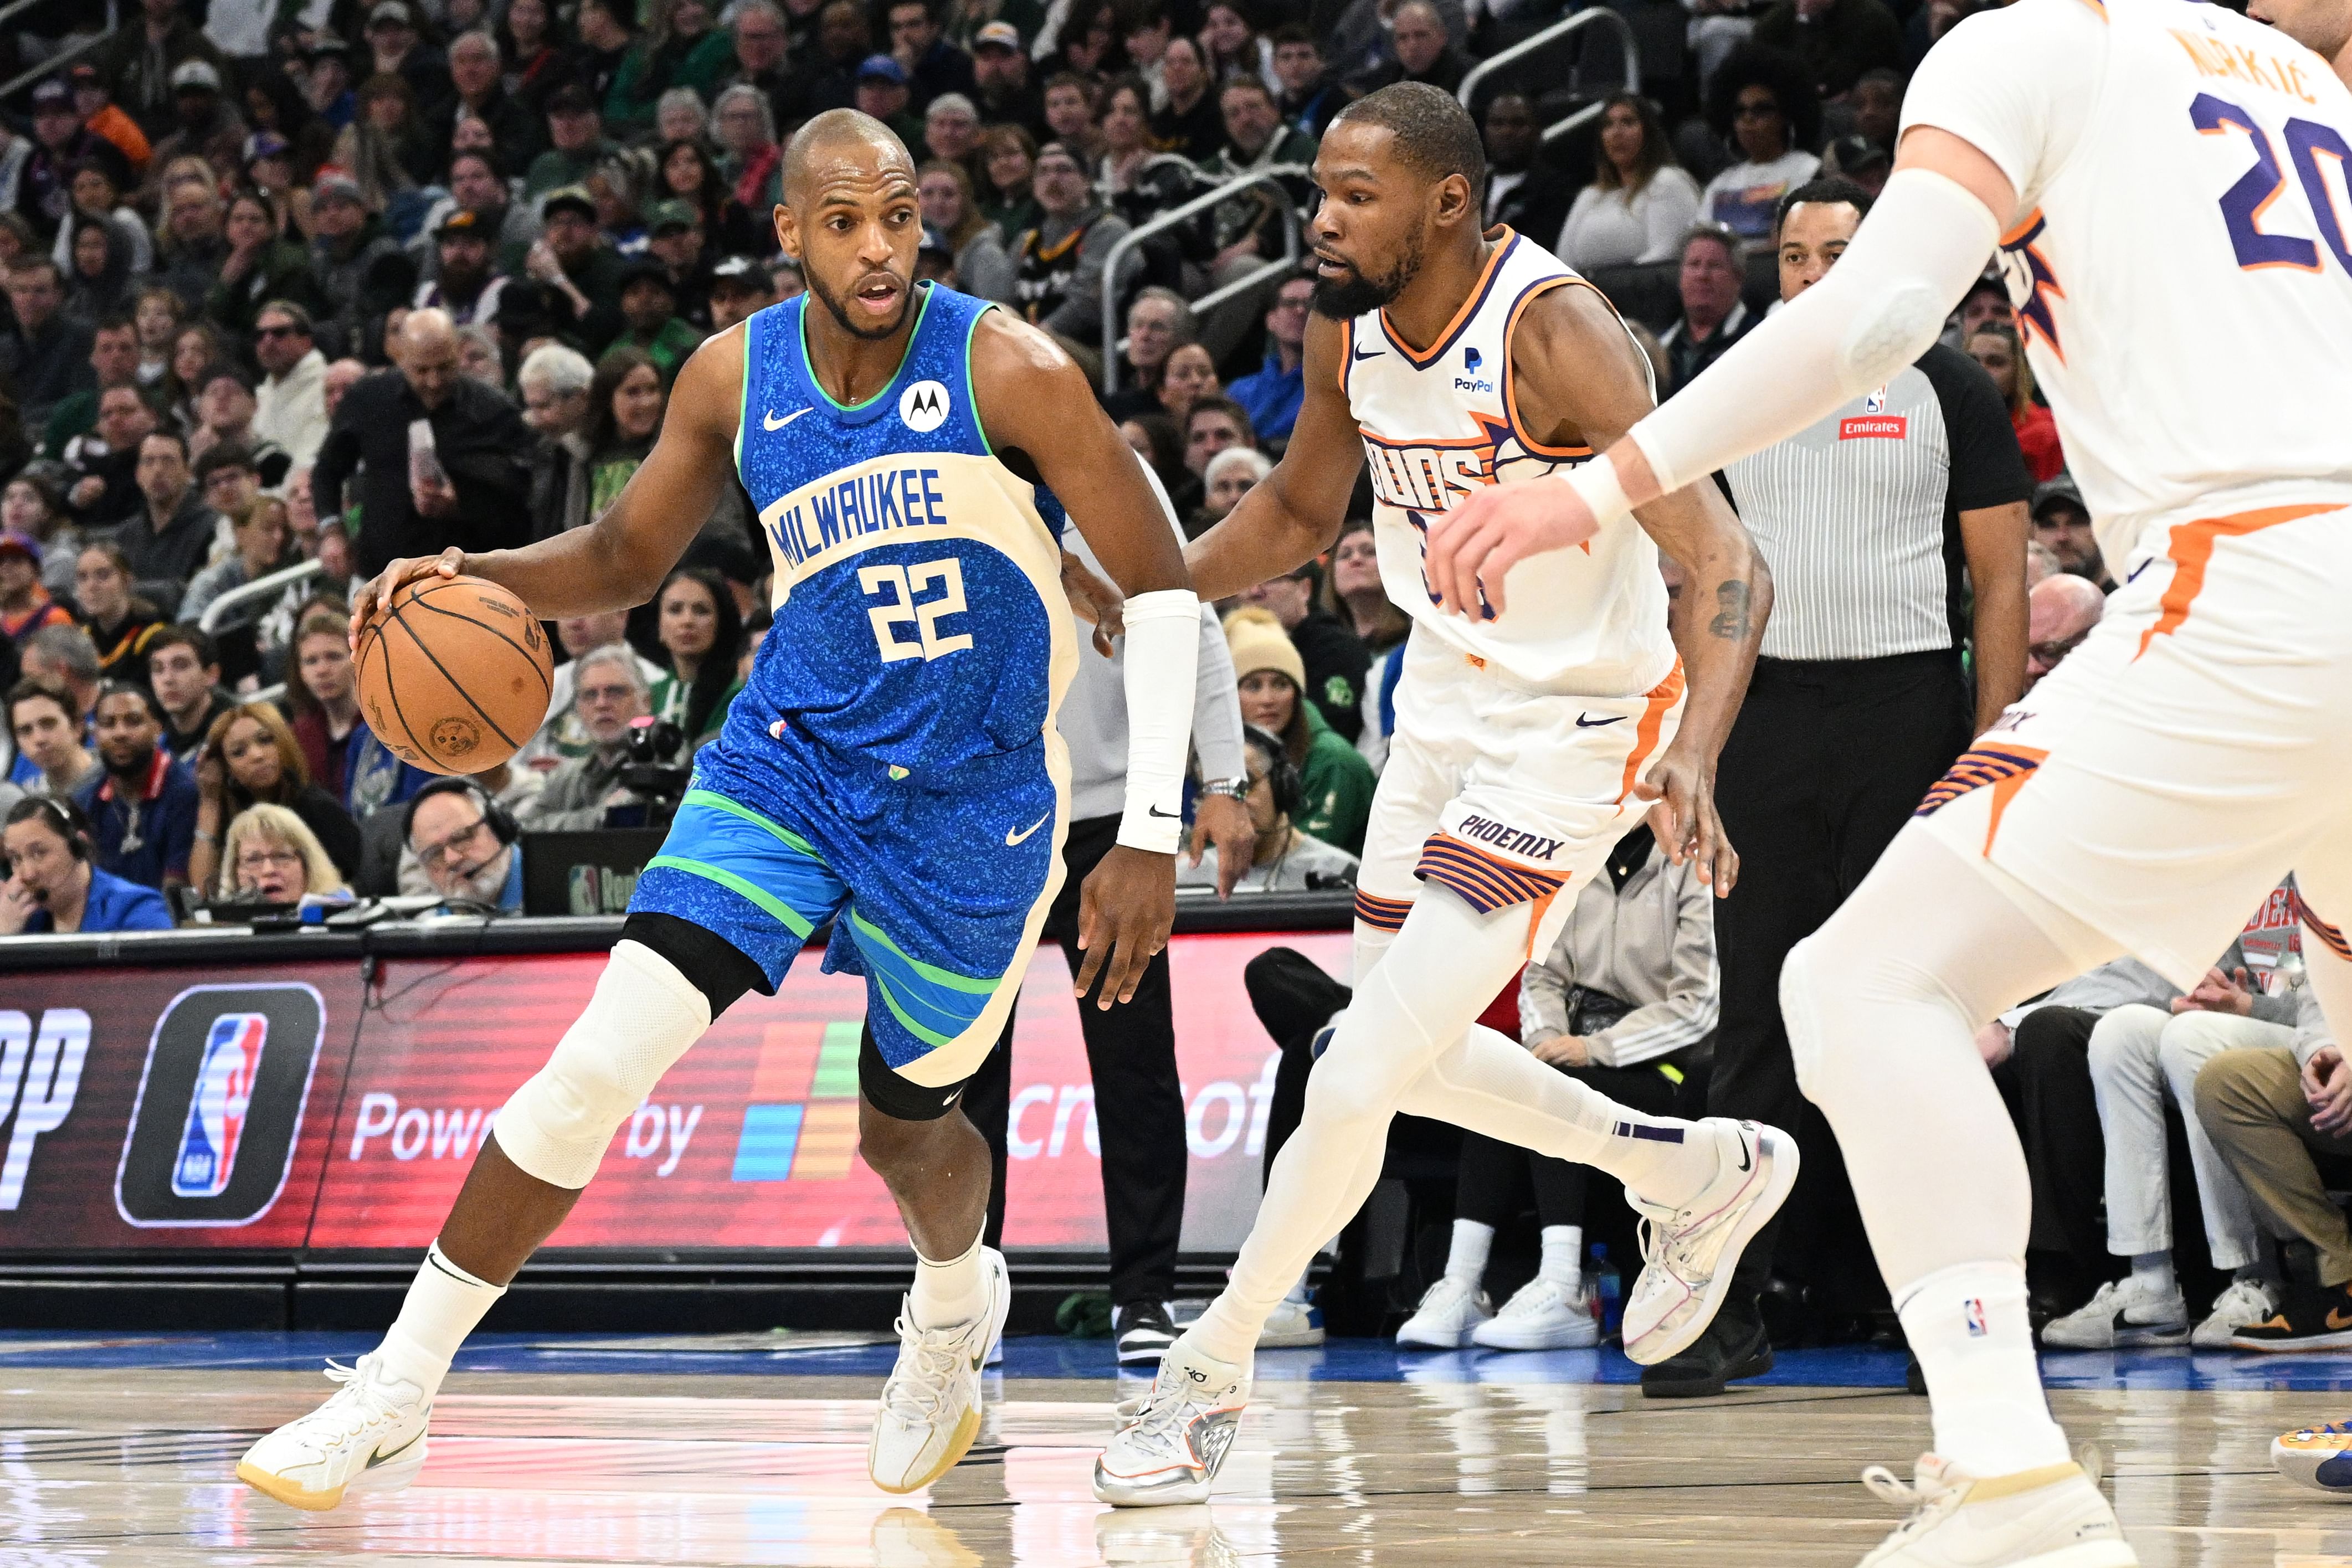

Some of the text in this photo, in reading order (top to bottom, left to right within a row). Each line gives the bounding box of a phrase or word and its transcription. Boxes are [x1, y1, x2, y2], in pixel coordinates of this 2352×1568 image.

[1455, 378, 1493, 392] PayPal
[1845, 420, 1899, 434] Emirates
[769, 469, 947, 570] MILWAUKEE
[857, 557, 974, 664] 22
[1459, 814, 1565, 860] PHOENIX
[625, 1097, 703, 1177] by
